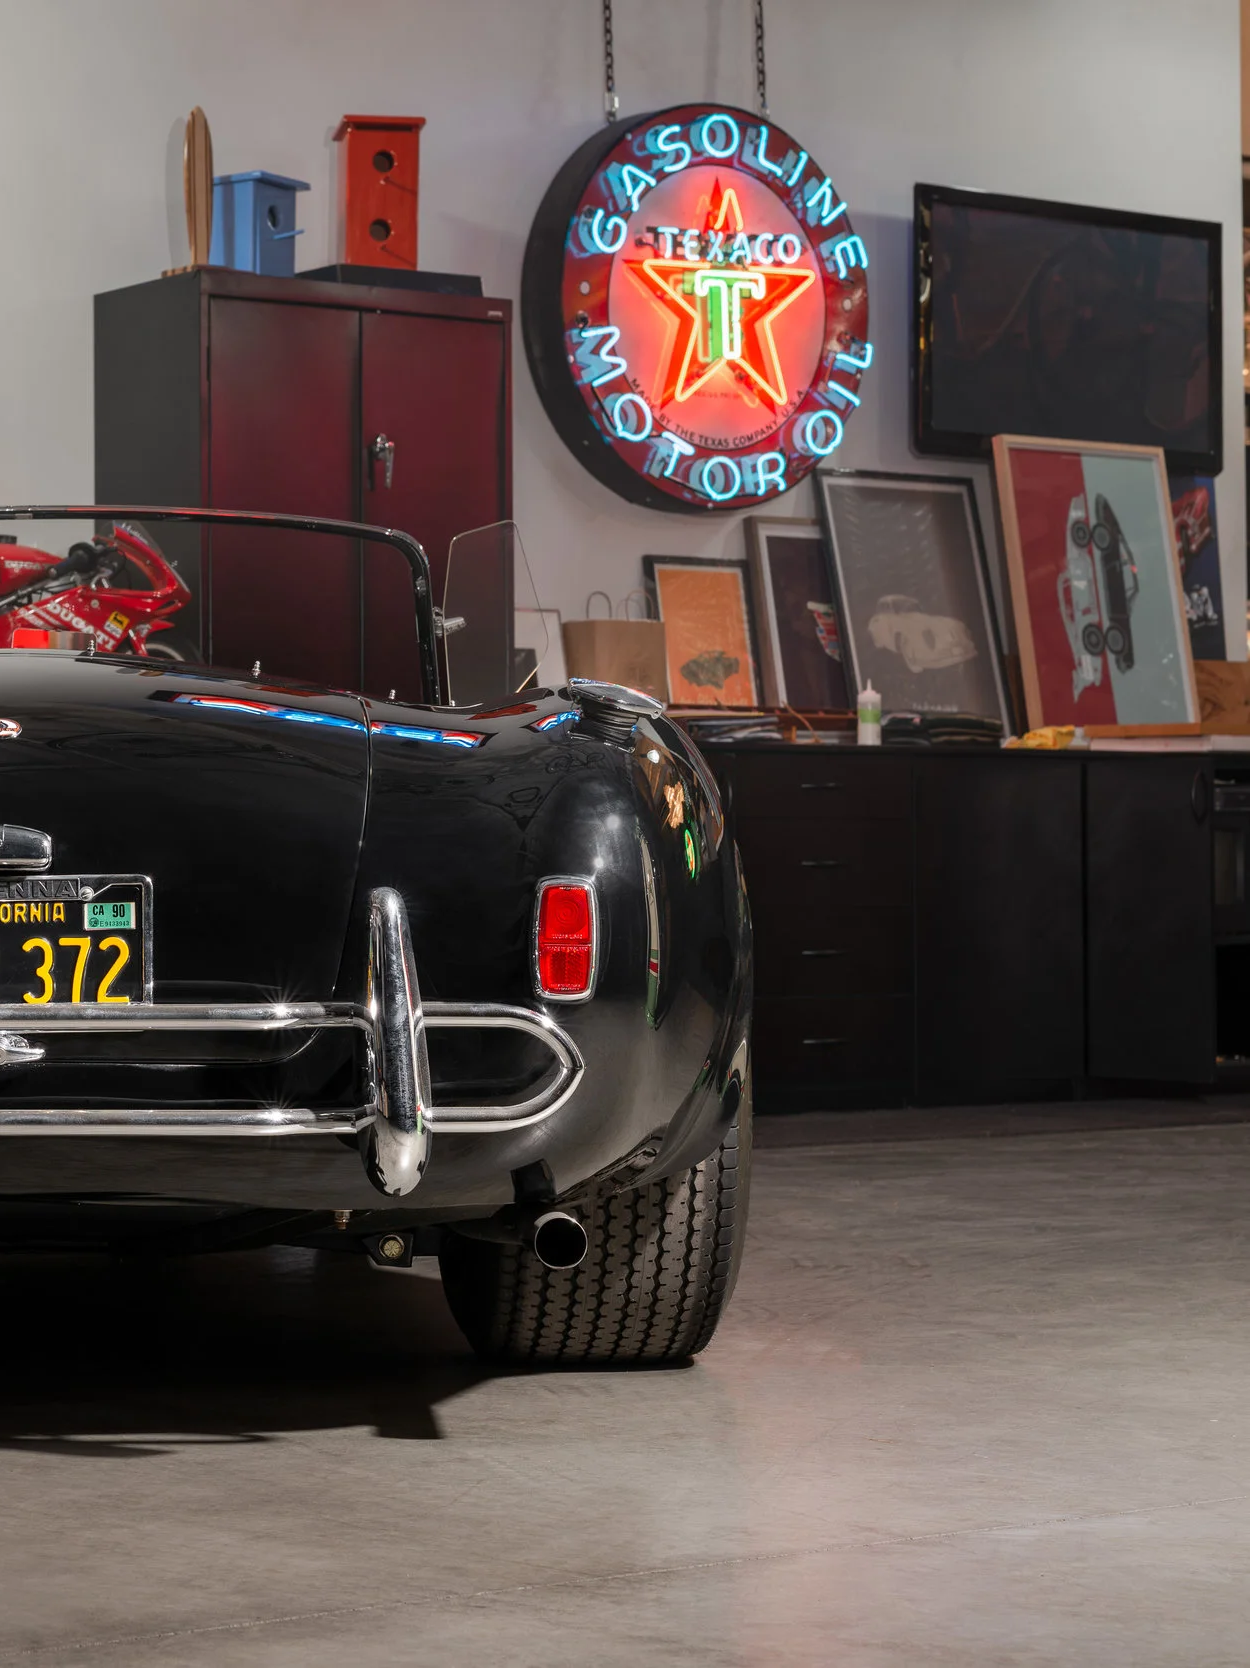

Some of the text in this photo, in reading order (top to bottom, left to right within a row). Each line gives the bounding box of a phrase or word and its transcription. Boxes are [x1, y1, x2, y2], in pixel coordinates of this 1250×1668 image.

[591, 113, 870, 280] GASOLINE
[656, 225, 802, 265] TEXACO
[694, 269, 766, 360] T
[579, 325, 873, 501] MOTOR OIL
[659, 413, 671, 426] BY
[675, 423, 695, 442] THE
[698, 436, 729, 448] TEXAS
[732, 419, 778, 447] COMPANY
[92, 904, 125, 917] CA 90
[22, 937, 130, 1005] 372
